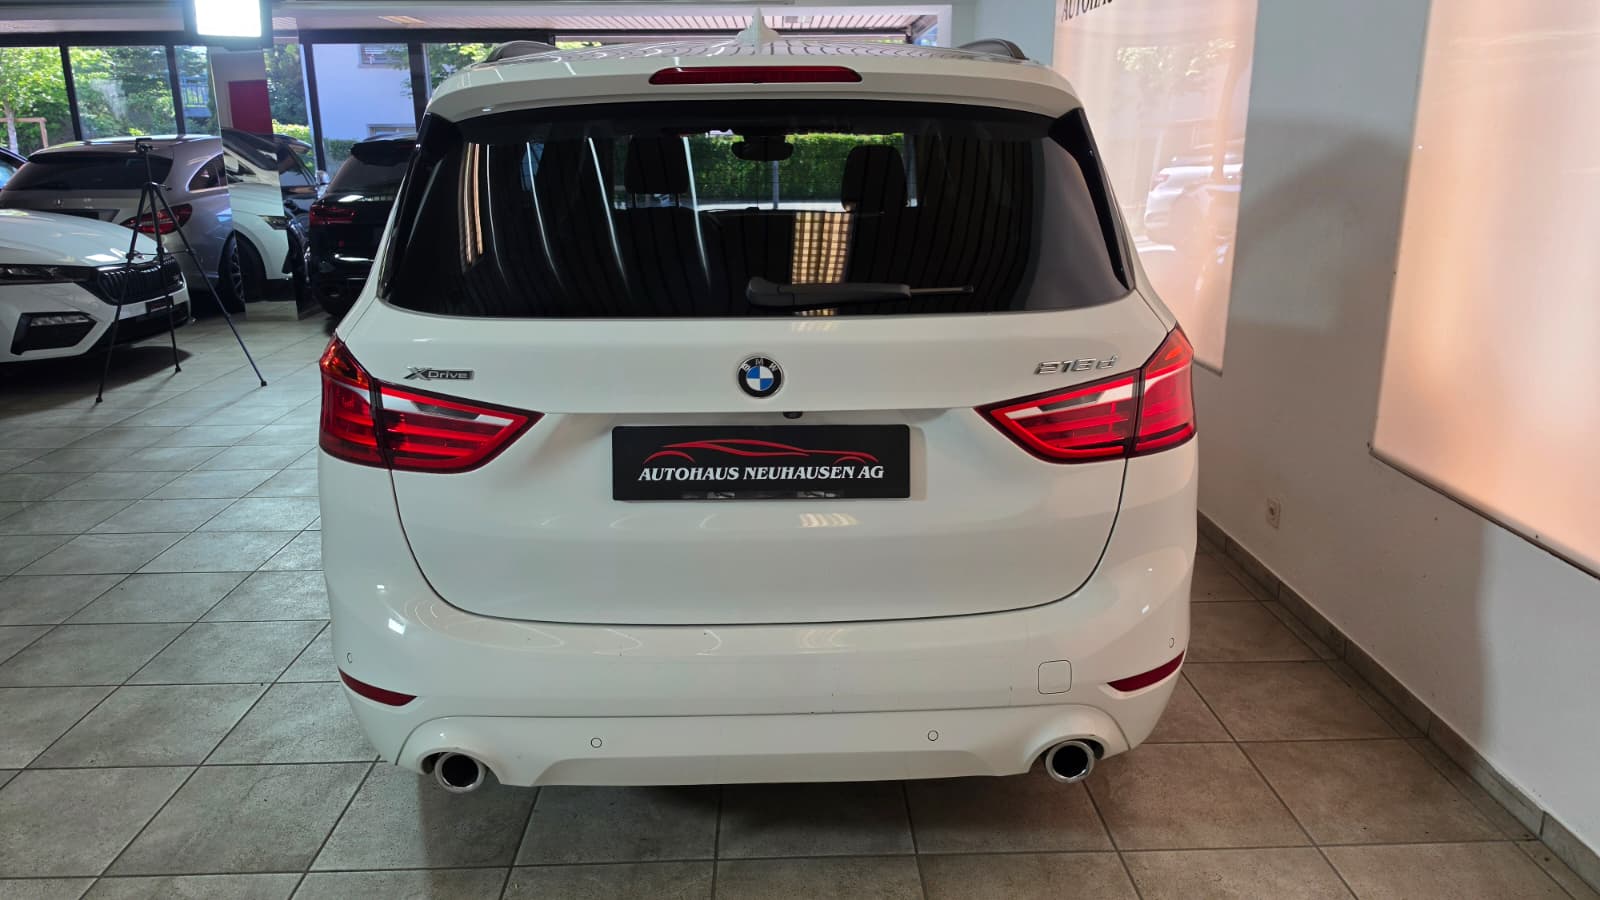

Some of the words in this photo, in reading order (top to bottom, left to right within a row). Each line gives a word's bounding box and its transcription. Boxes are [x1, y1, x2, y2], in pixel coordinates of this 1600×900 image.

[638, 467, 739, 482] AUTOHAUS
[743, 466, 855, 480] NEUHAUSEN
[857, 466, 884, 479] AG
